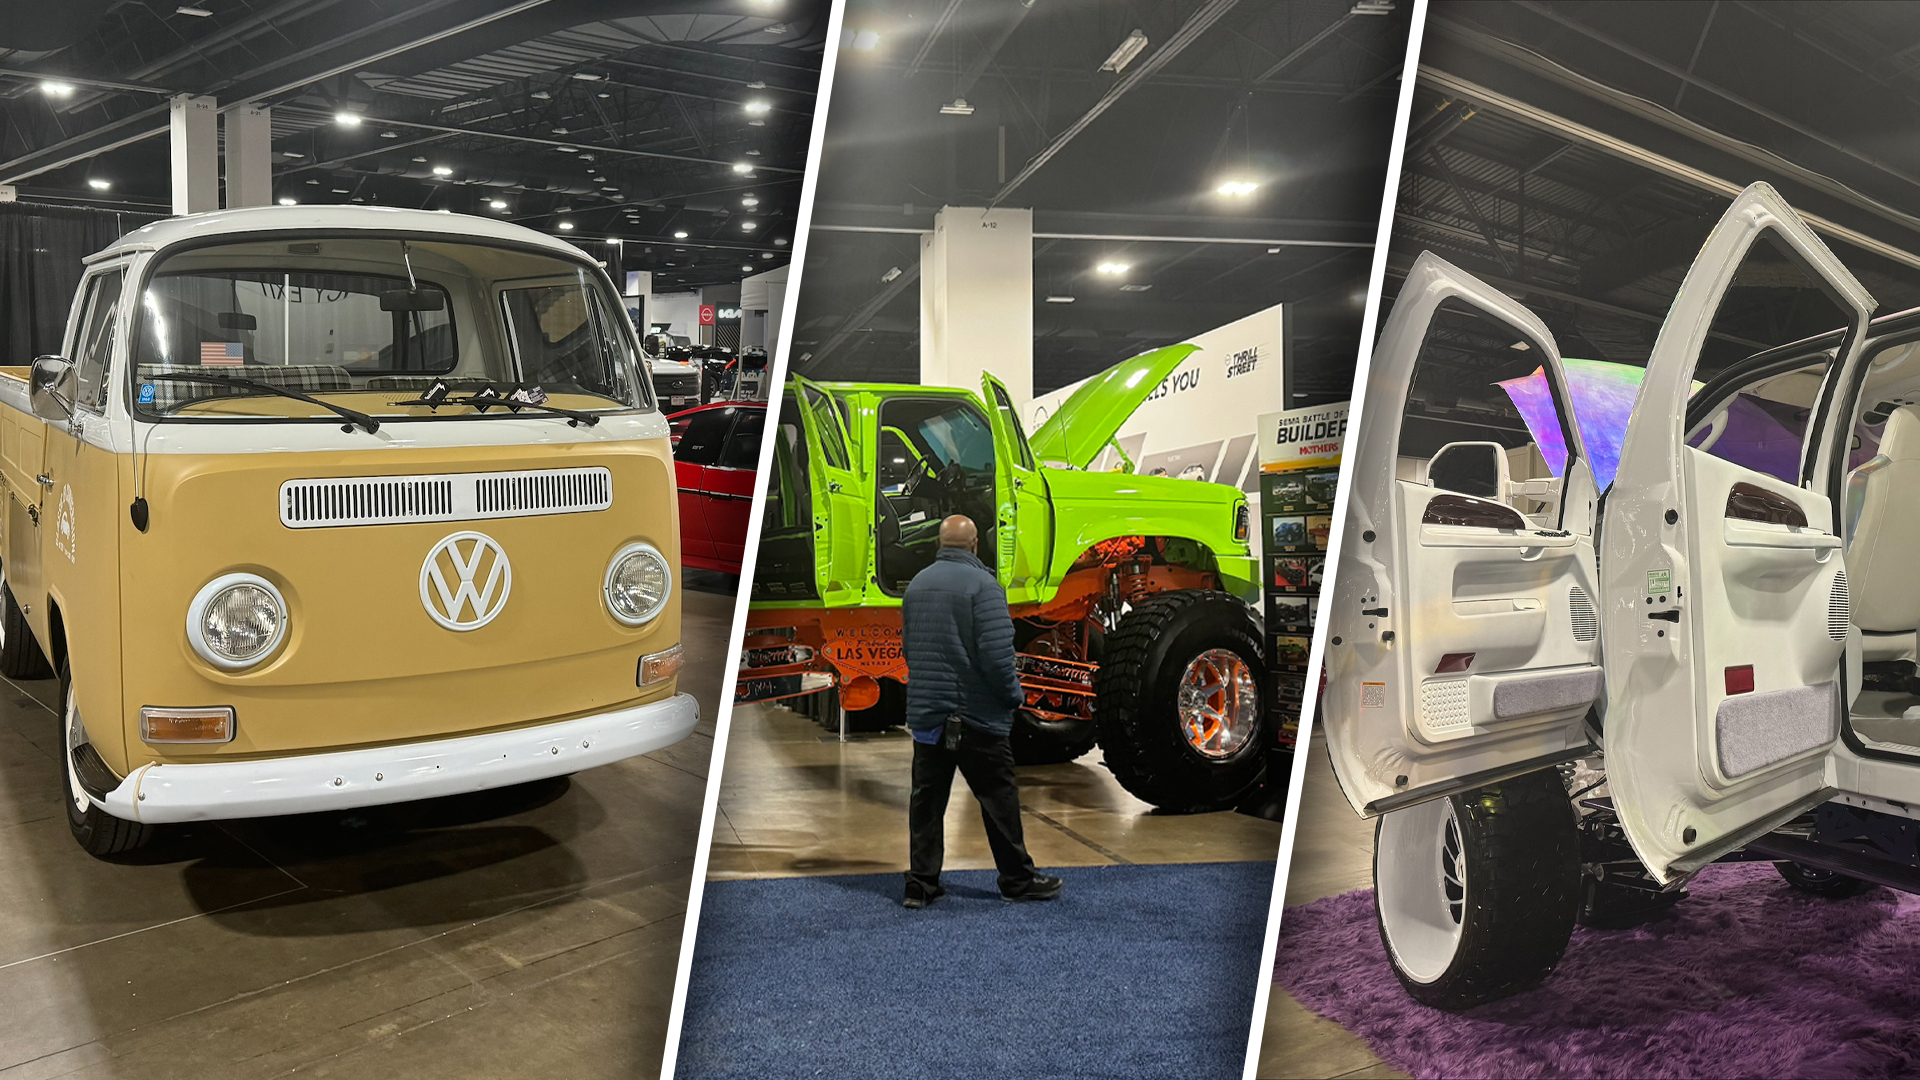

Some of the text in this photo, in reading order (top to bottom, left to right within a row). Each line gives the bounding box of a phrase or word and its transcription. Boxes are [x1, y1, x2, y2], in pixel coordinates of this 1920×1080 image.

[1233, 346, 1258, 365] THRILL
[1227, 358, 1258, 378] STREET
[1172, 367, 1200, 393] YOU
[1279, 410, 1344, 427] SEMA BATTLE OF
[1300, 442, 1339, 455] MOTHERS
[426, 536, 508, 626] VW
[837, 648, 863, 660] LAS
